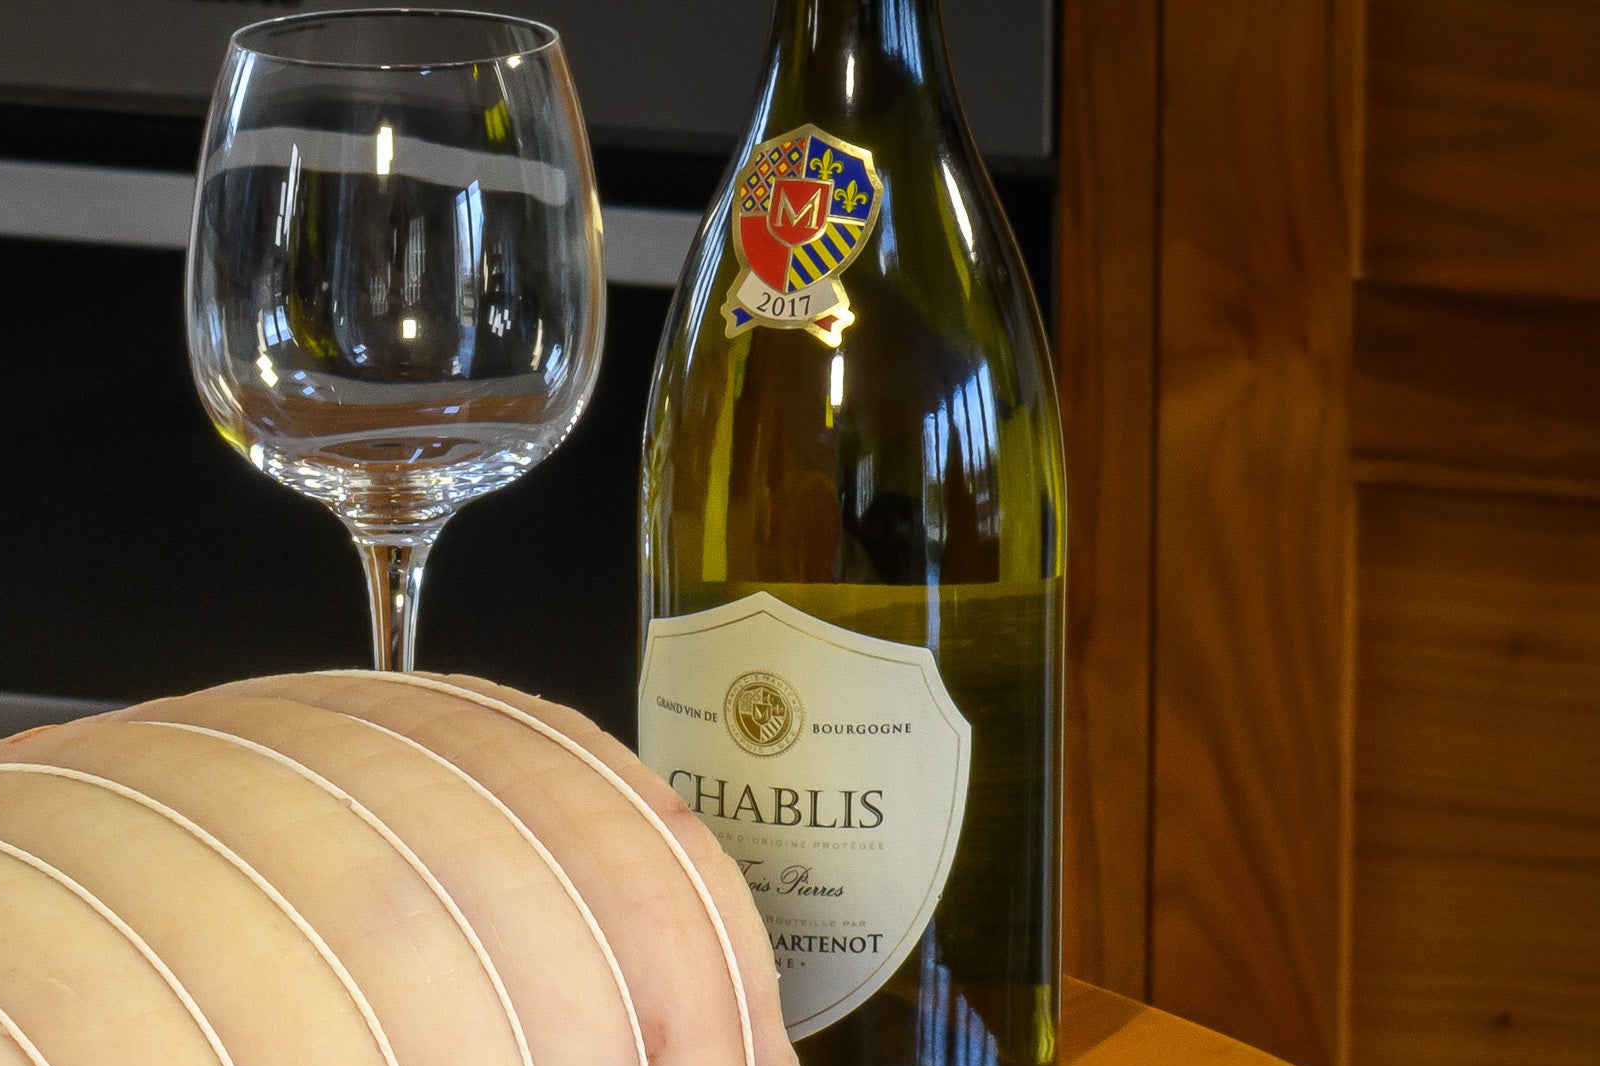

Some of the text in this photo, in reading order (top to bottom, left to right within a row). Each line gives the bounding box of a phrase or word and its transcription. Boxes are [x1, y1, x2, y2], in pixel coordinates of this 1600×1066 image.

[774, 187, 822, 229] M
[756, 292, 811, 317] 2017
[656, 696, 718, 723] GRAND VIN DE
[812, 723, 912, 735] BOURGOGNE
[669, 769, 884, 829] CHABLIS
[777, 864, 844, 897] Pierres
[843, 920, 866, 928] PAR
